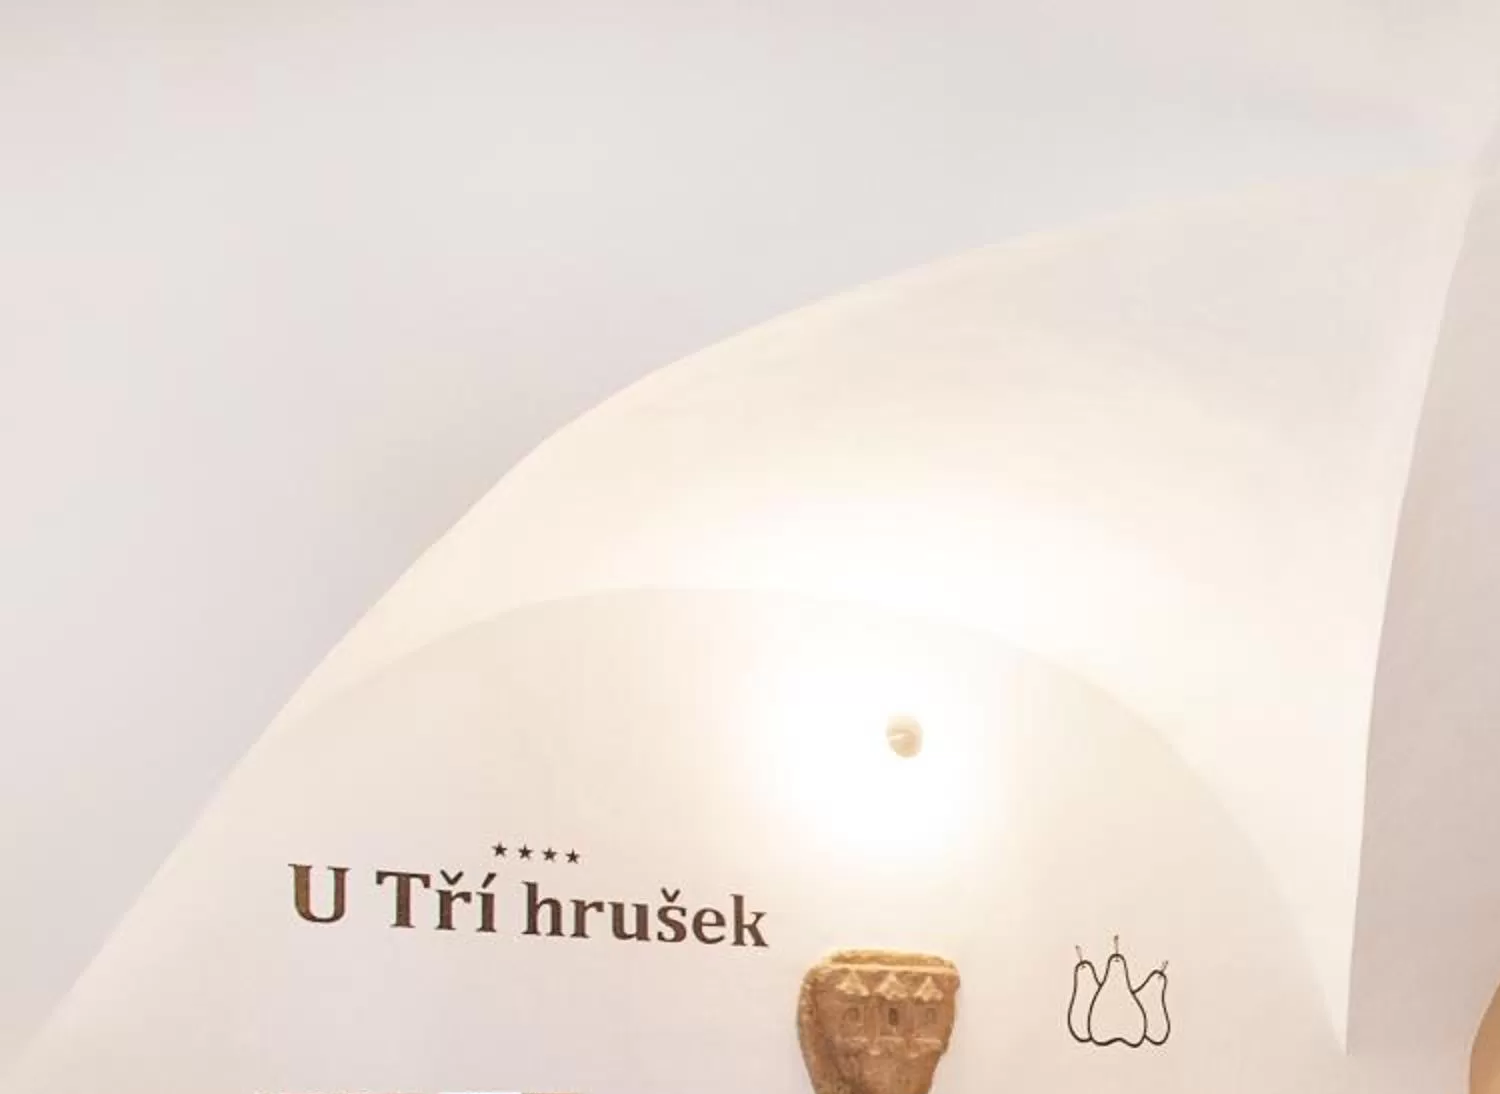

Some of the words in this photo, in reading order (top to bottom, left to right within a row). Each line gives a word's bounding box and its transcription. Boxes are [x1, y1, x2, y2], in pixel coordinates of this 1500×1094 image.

[287, 863, 352, 924] U
[375, 868, 498, 933] Tří
[521, 881, 769, 948] hrušek
